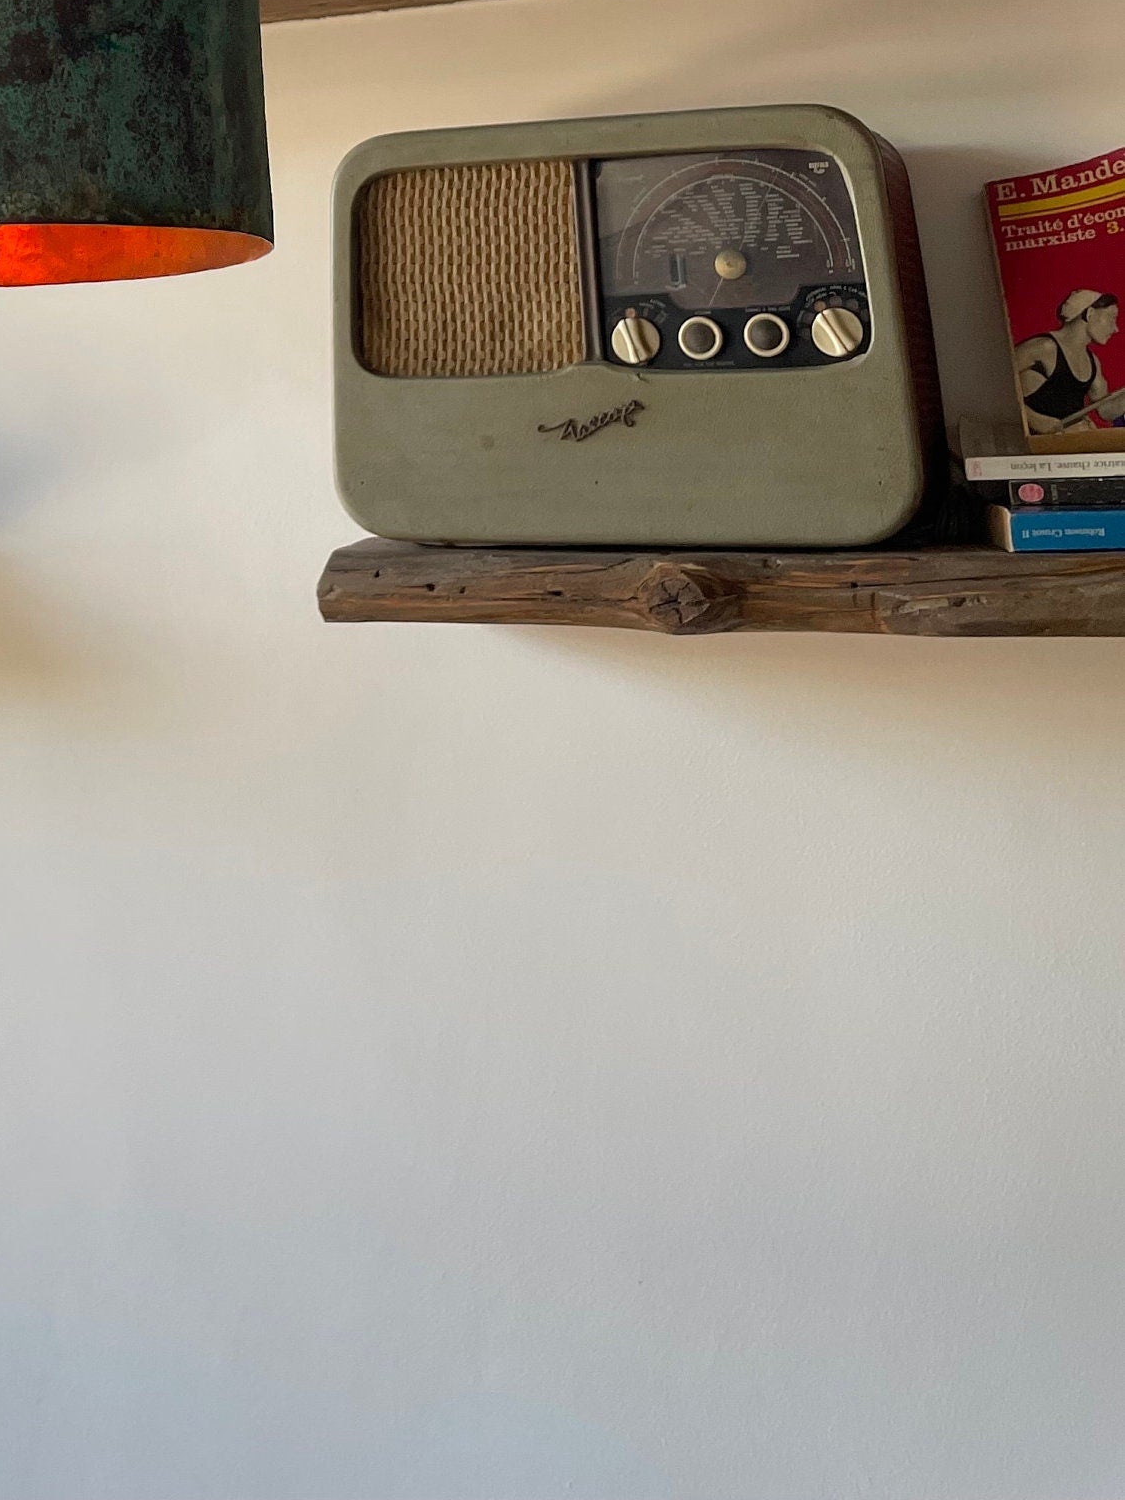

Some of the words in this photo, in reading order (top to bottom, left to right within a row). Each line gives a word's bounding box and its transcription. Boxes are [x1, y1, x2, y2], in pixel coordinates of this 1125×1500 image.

[995, 181, 1026, 201] E.
[1029, 151, 1125, 197] Mande
[1001, 218, 1064, 239] Traité
[1003, 228, 1096, 251] marxiste
[1037, 462, 1052, 473] La
